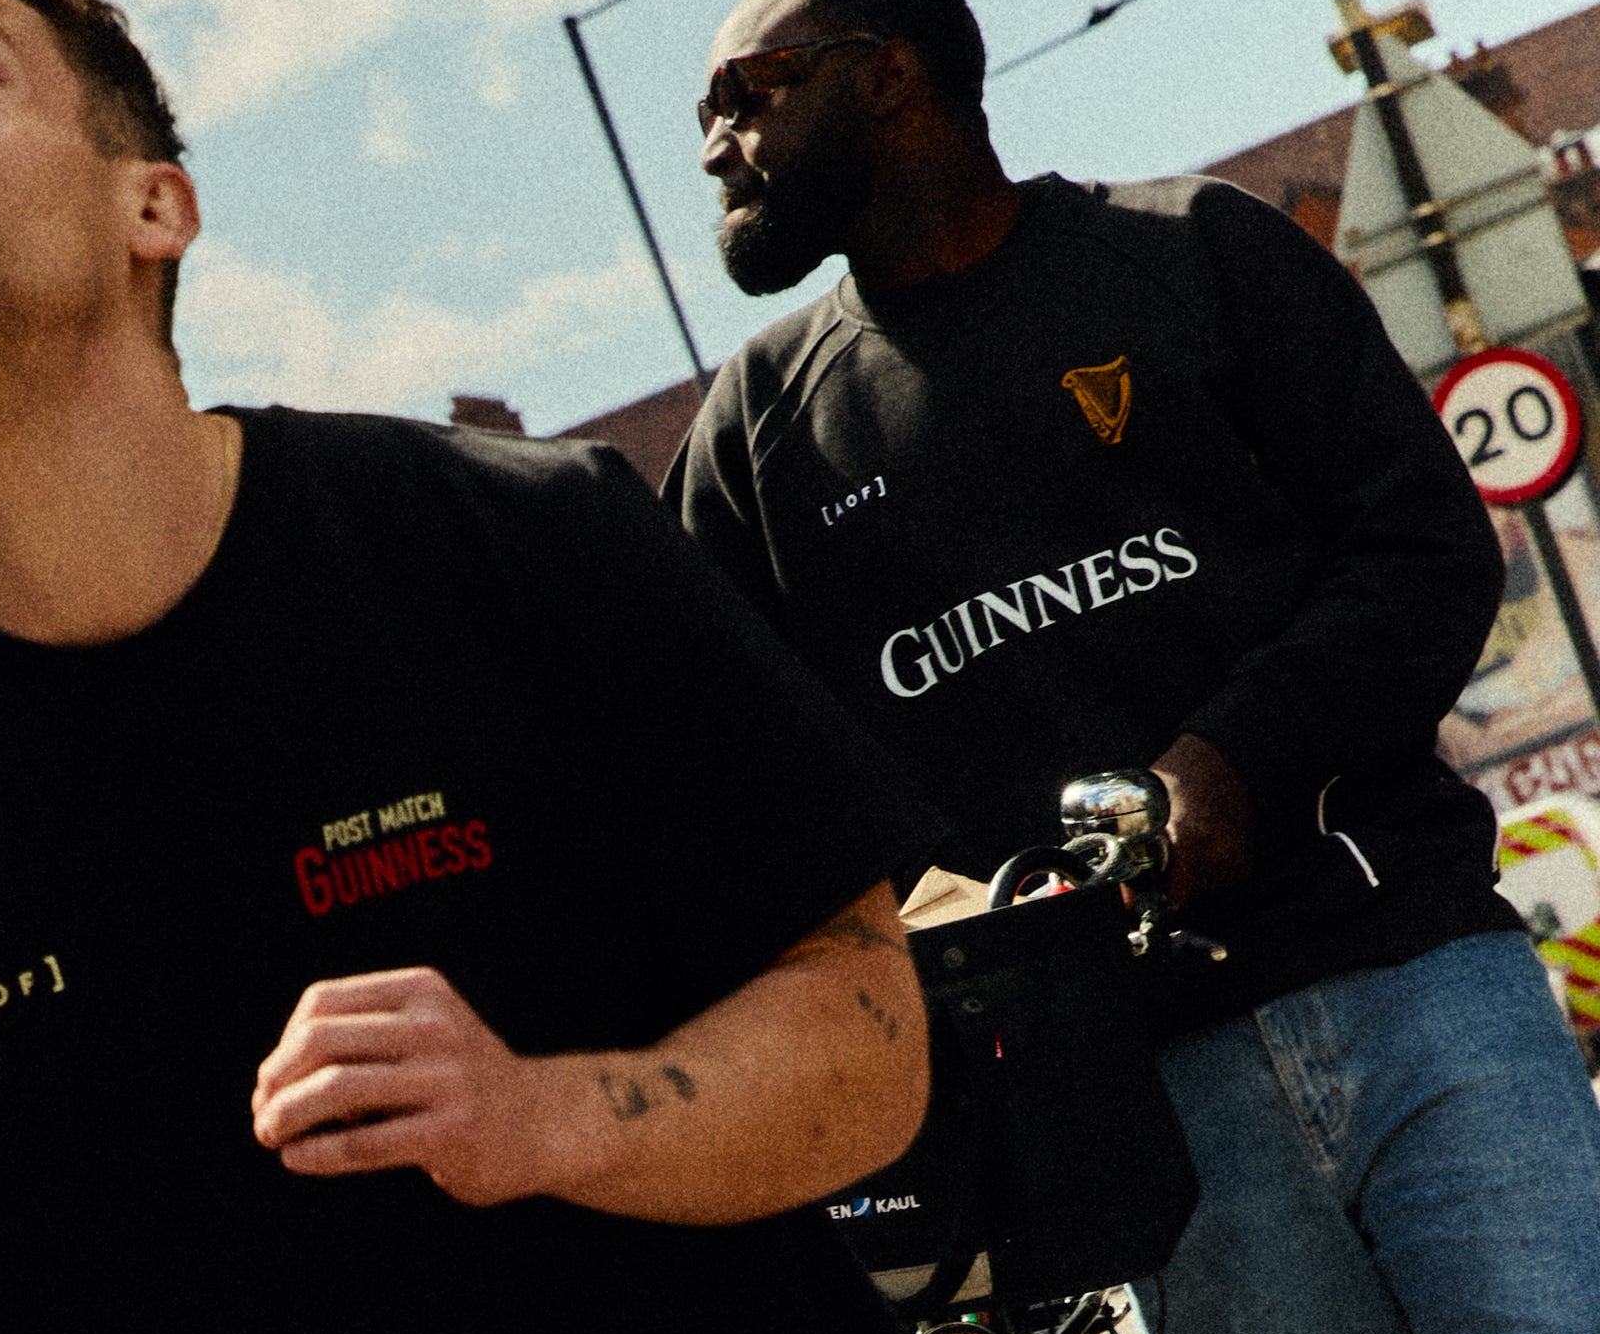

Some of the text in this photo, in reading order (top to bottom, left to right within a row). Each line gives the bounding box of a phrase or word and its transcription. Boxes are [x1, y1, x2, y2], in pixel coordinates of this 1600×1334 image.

[1455, 385, 1553, 466] 20
[879, 526, 1200, 699] GUINNESS
[322, 792, 446, 851] POST MATCH
[294, 819, 493, 914] GUINNESS
[826, 1195, 921, 1220] EN KAUL
